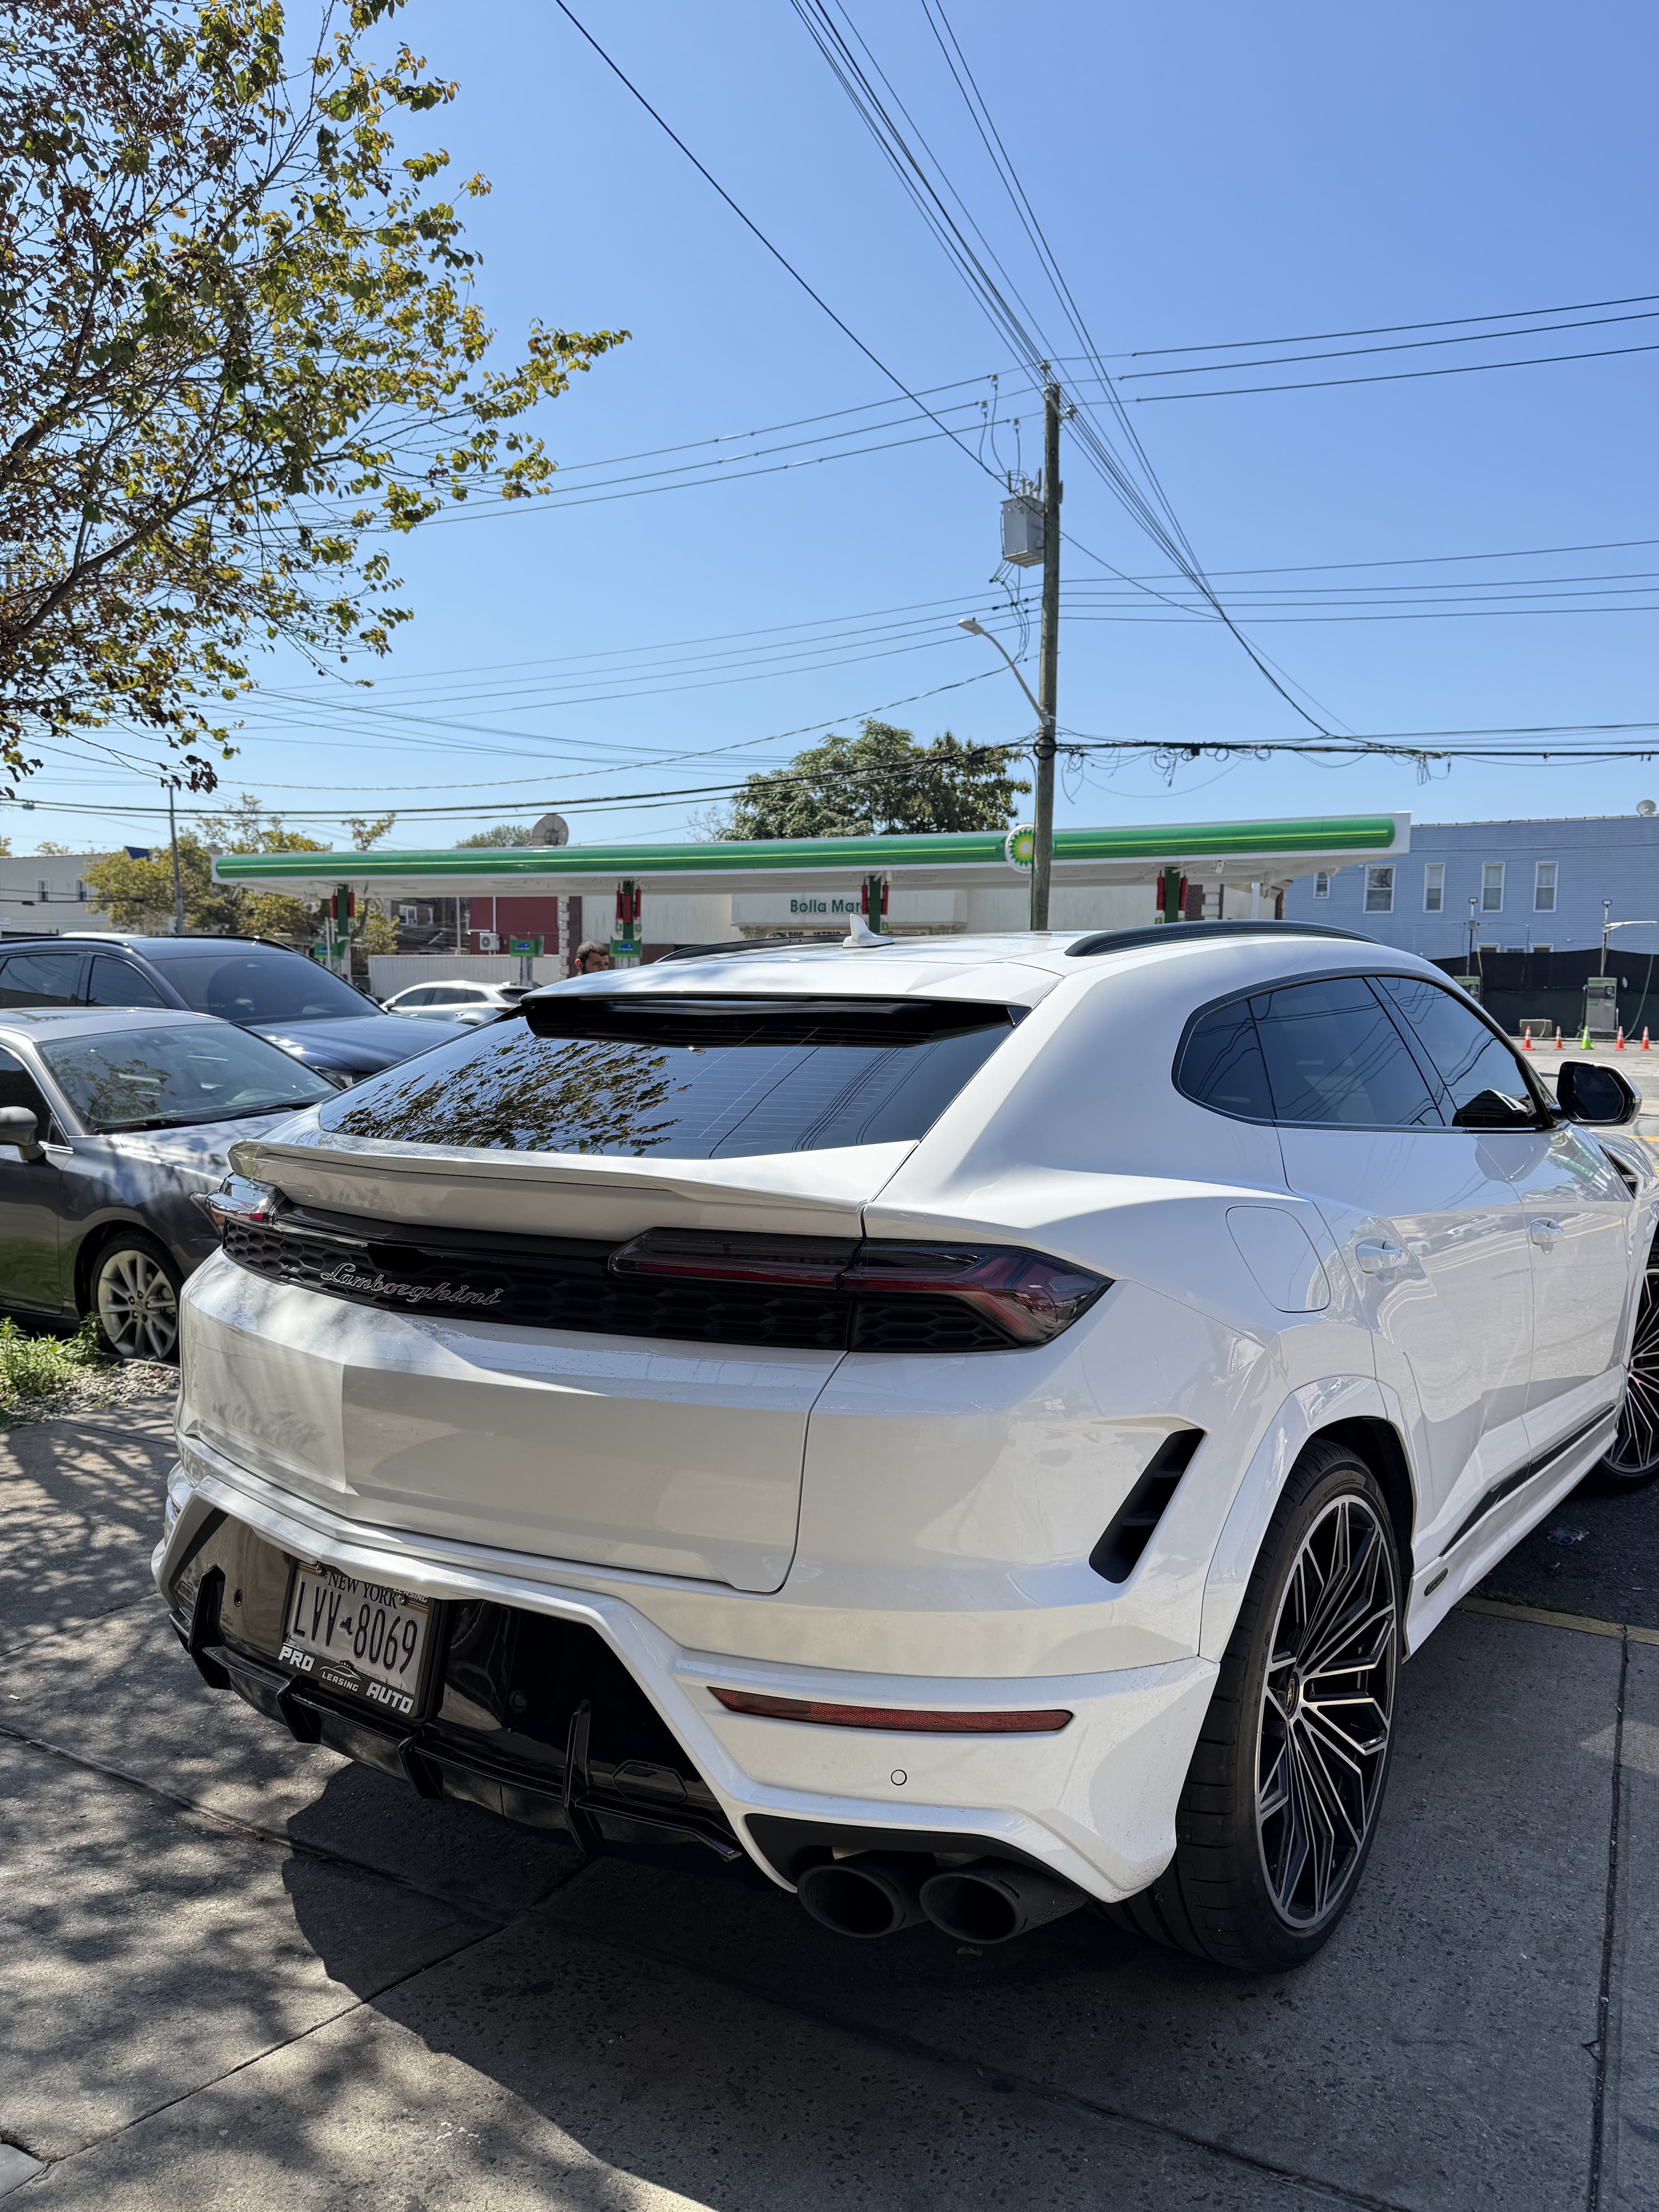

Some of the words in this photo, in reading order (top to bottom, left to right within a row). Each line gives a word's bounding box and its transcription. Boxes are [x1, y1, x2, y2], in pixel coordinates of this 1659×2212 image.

[790, 899, 826, 912] Bolla
[832, 899, 861, 913] Mar
[320, 1262, 505, 1305] Lamborghini
[327, 1572, 359, 1595] NEW
[362, 1583, 397, 1609] YORK
[293, 1581, 342, 1646] LVV
[353, 1603, 417, 1674] 8069
[278, 1646, 315, 1672] PRO
[321, 1671, 359, 1692] LEASING
[366, 1681, 414, 1714] AUTO
